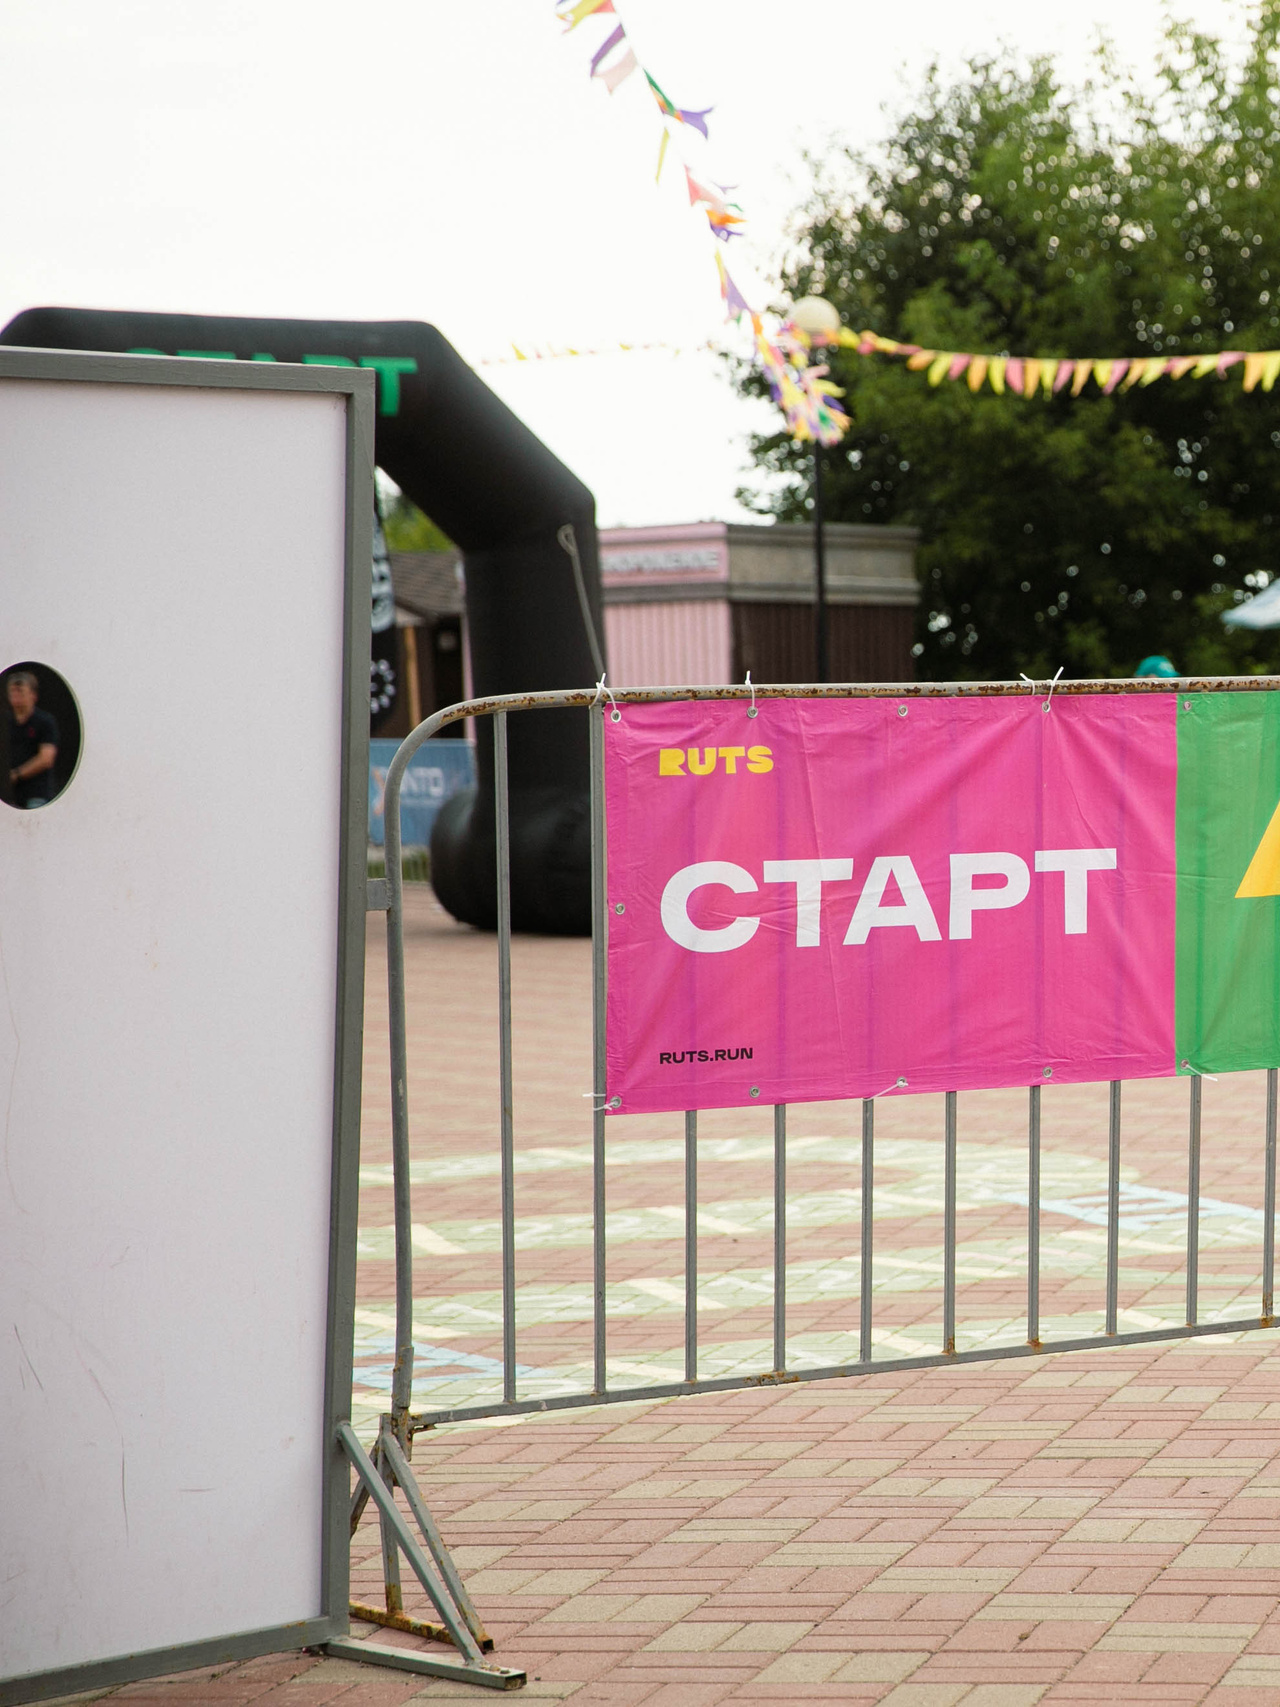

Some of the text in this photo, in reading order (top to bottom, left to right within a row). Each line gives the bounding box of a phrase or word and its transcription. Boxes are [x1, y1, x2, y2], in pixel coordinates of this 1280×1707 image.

[659, 745, 774, 776] RUTS
[660, 848, 1117, 953] СТАРТ
[659, 1047, 753, 1064] RUTS.RUN
